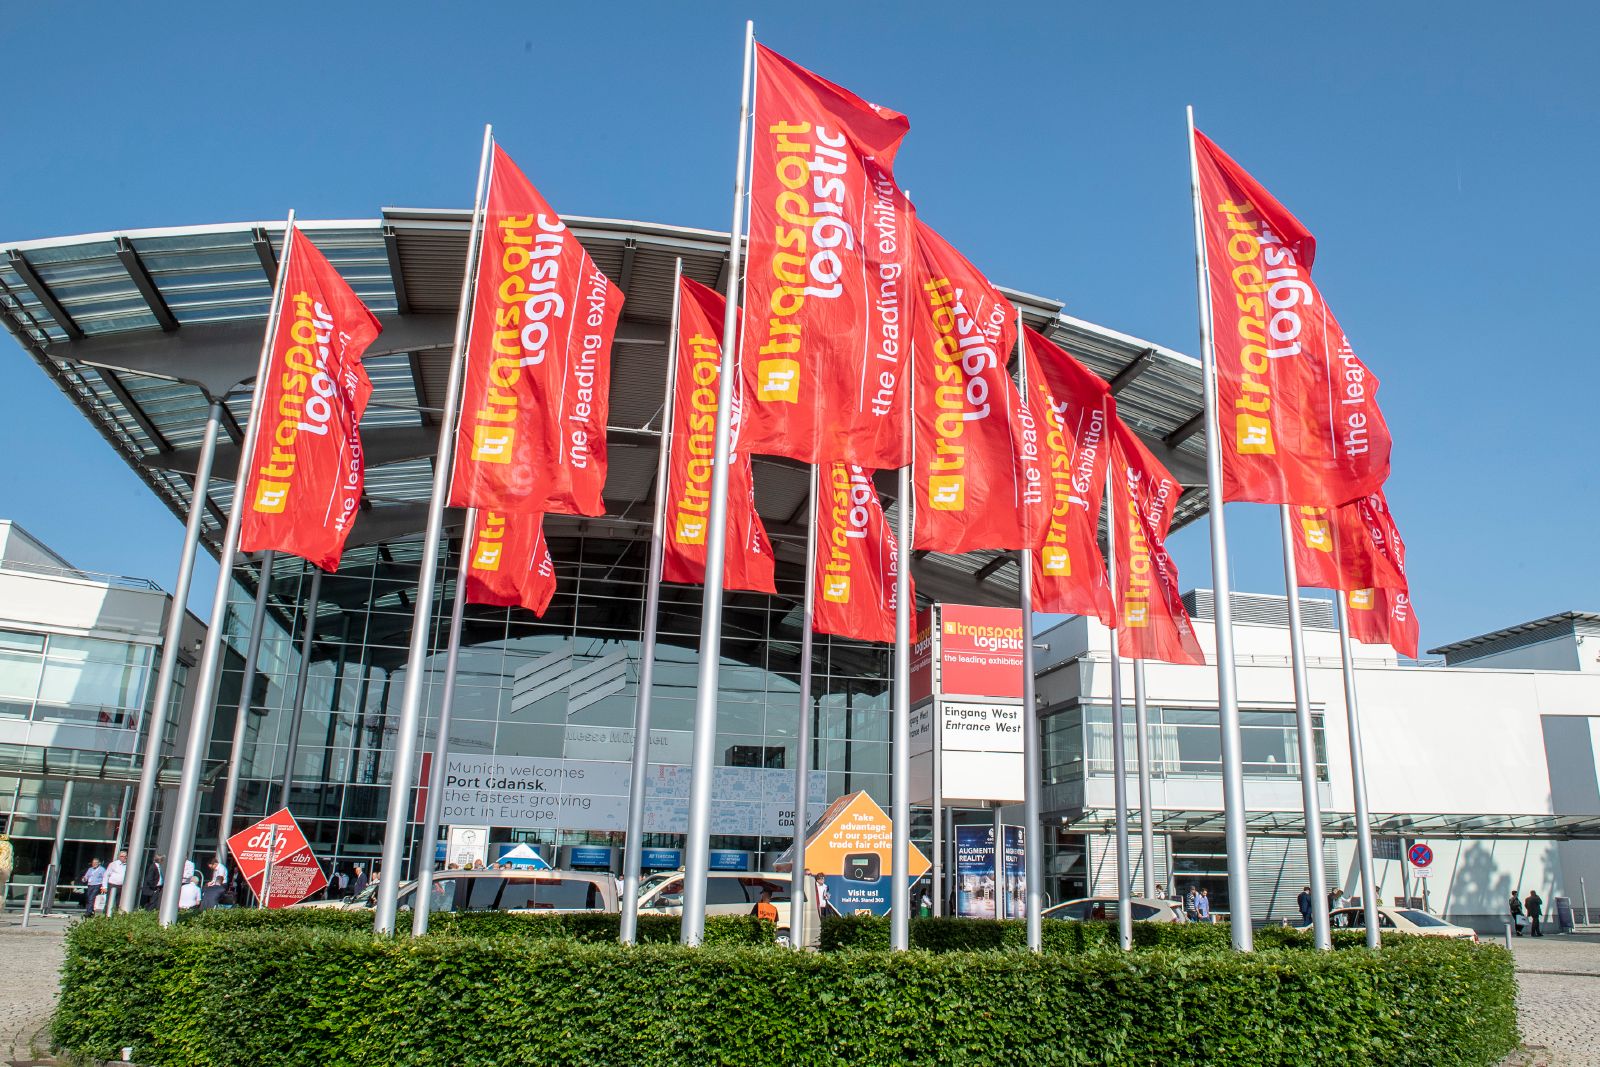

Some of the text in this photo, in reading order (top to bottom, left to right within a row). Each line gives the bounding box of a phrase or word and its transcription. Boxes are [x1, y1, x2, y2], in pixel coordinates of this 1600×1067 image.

[804, 126, 854, 299] logistic
[759, 120, 819, 355] transport
[520, 213, 565, 368] logistic
[872, 170, 902, 417] the leading exhibiti
[1256, 220, 1313, 359] logist
[475, 213, 534, 424] transport
[1218, 199, 1275, 419] transport
[569, 262, 608, 469] the leading exhib
[923, 276, 964, 471] transport
[260, 290, 318, 480] transport
[1338, 335, 1368, 457] the leadi
[677, 333, 719, 512] transport
[1076, 409, 1104, 493] exhibition
[1024, 467, 1041, 506] the
[334, 498, 355, 532] the
[826, 462, 852, 572] transp
[957, 621, 1024, 639] transport
[974, 636, 1024, 652] logistic
[944, 653, 957, 662] the
[958, 655, 987, 665] leading
[944, 706, 1018, 720] Eingang West
[945, 720, 1022, 733] Entrance West
[446, 775, 548, 792] Port Gdańsk,
[448, 761, 585, 779] Munich welcomes
[445, 789, 592, 810] the fastest growing
[443, 806, 557, 821] port in Europe.
[840, 822, 887, 832] advantage
[852, 813, 874, 822] Take
[829, 841, 893, 849] trade fair offe
[833, 832, 843, 840] of
[863, 832, 892, 842] special
[292, 853, 311, 863] dbh
[958, 854, 986, 862] REALITY
[847, 889, 879, 897] Visit us!
